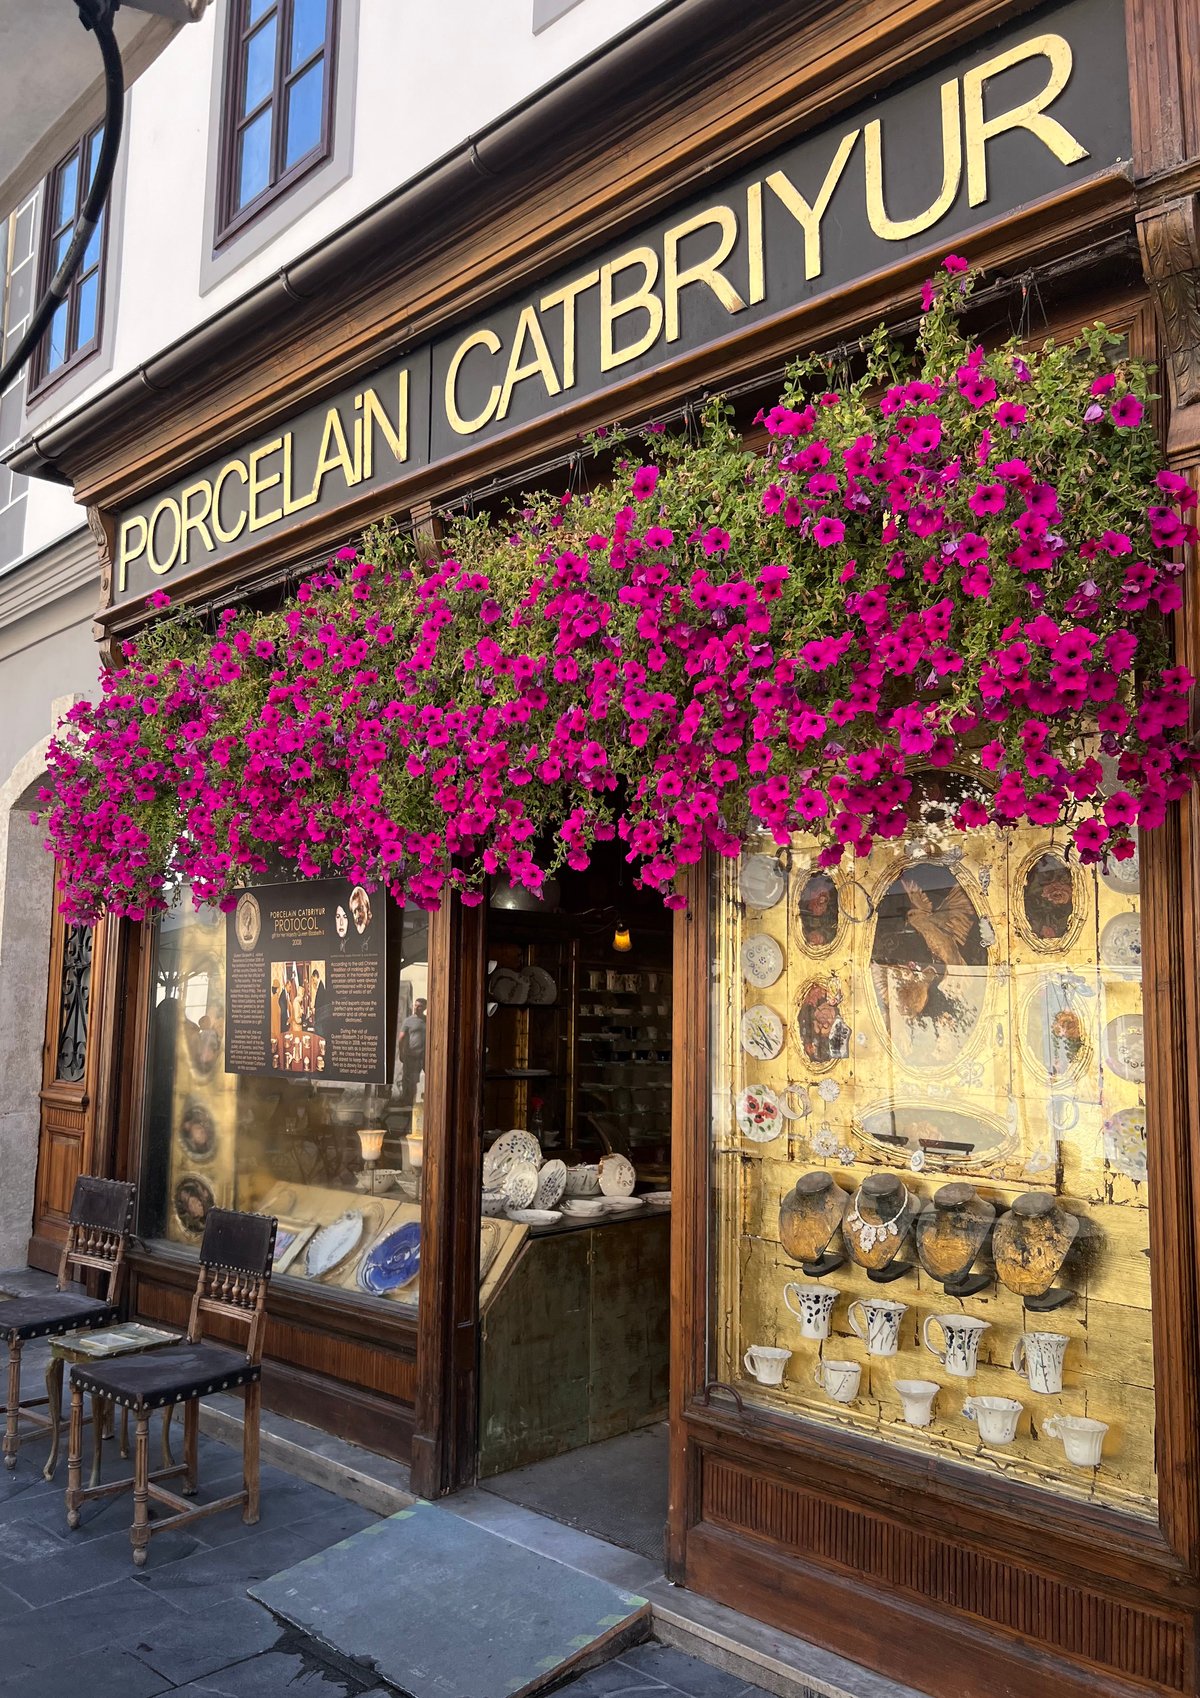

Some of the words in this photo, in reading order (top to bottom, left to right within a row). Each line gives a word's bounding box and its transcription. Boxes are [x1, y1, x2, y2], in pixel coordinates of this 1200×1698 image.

[444, 33, 1090, 435] CATBRIYUR
[298, 908, 325, 916] CATBRIYUR
[274, 916, 318, 932] PROTOCOL
